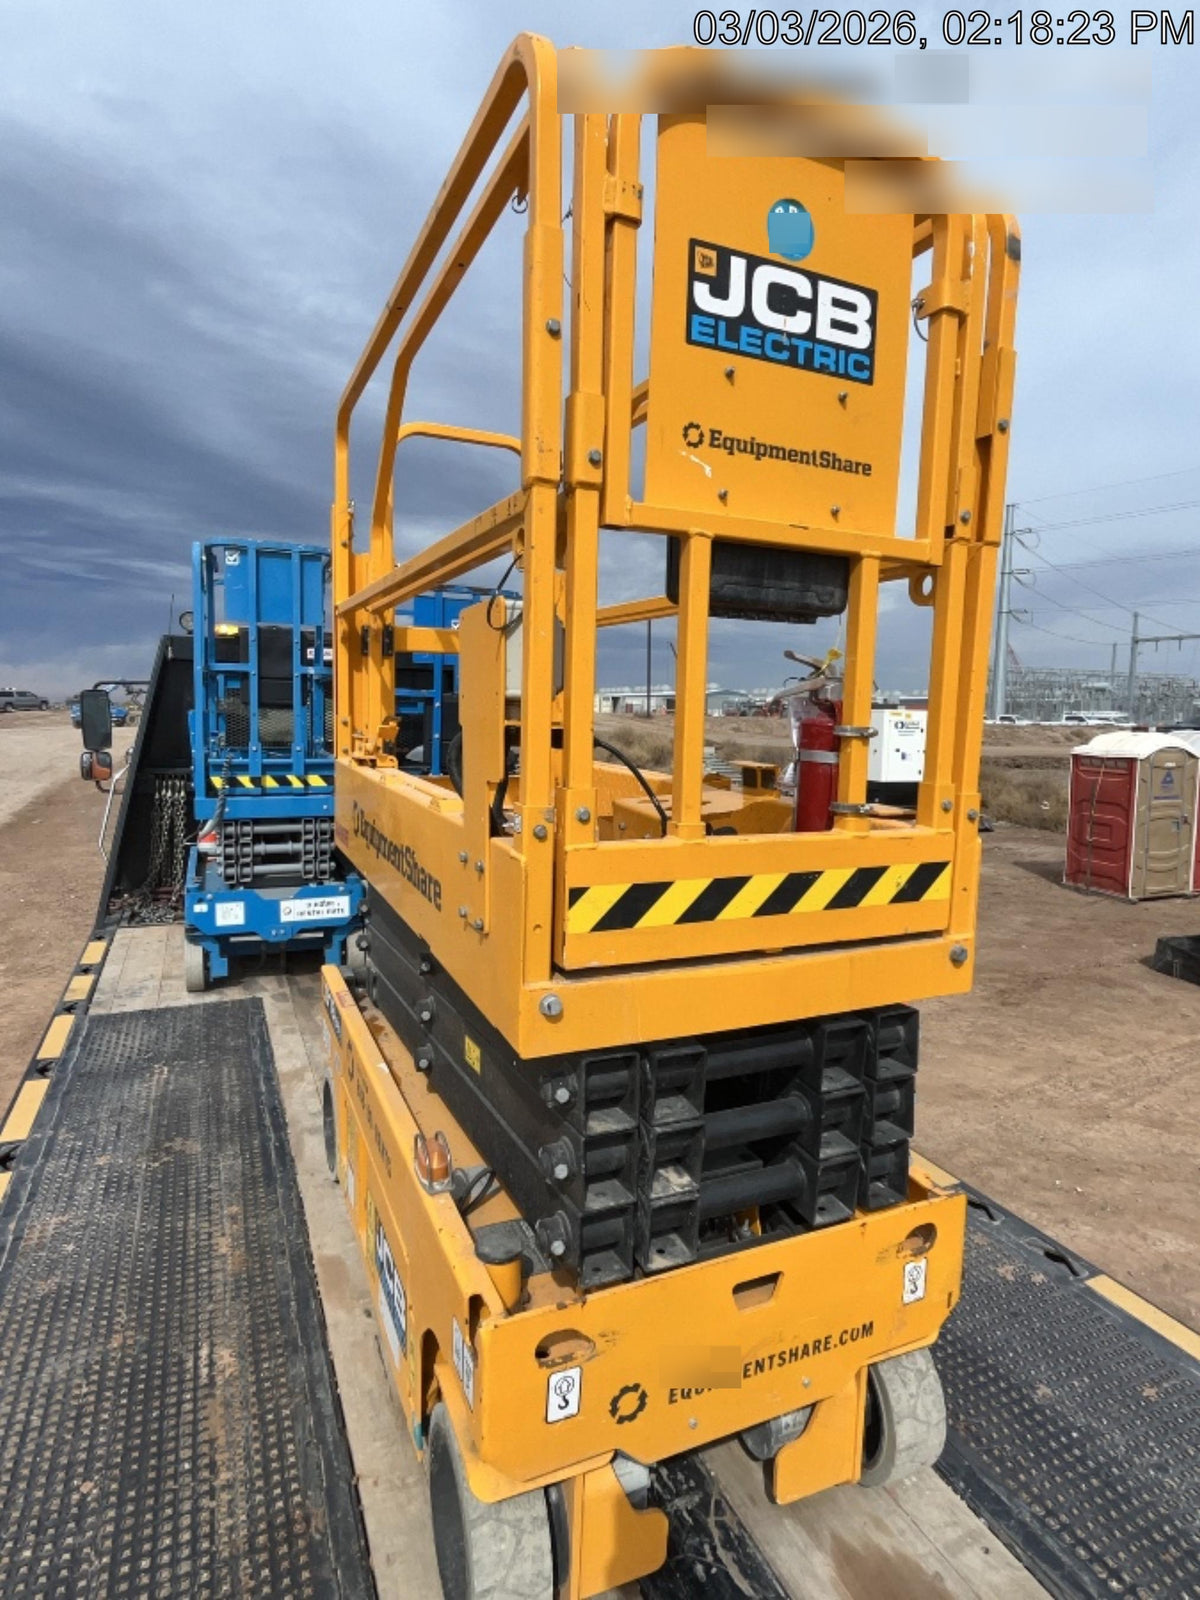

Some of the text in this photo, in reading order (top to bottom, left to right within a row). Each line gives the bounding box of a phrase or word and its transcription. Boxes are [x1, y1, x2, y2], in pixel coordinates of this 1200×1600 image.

[693, 255, 872, 350] JCB
[690, 314, 870, 380] ELECTRIC
[708, 427, 872, 477] EquipmentShare
